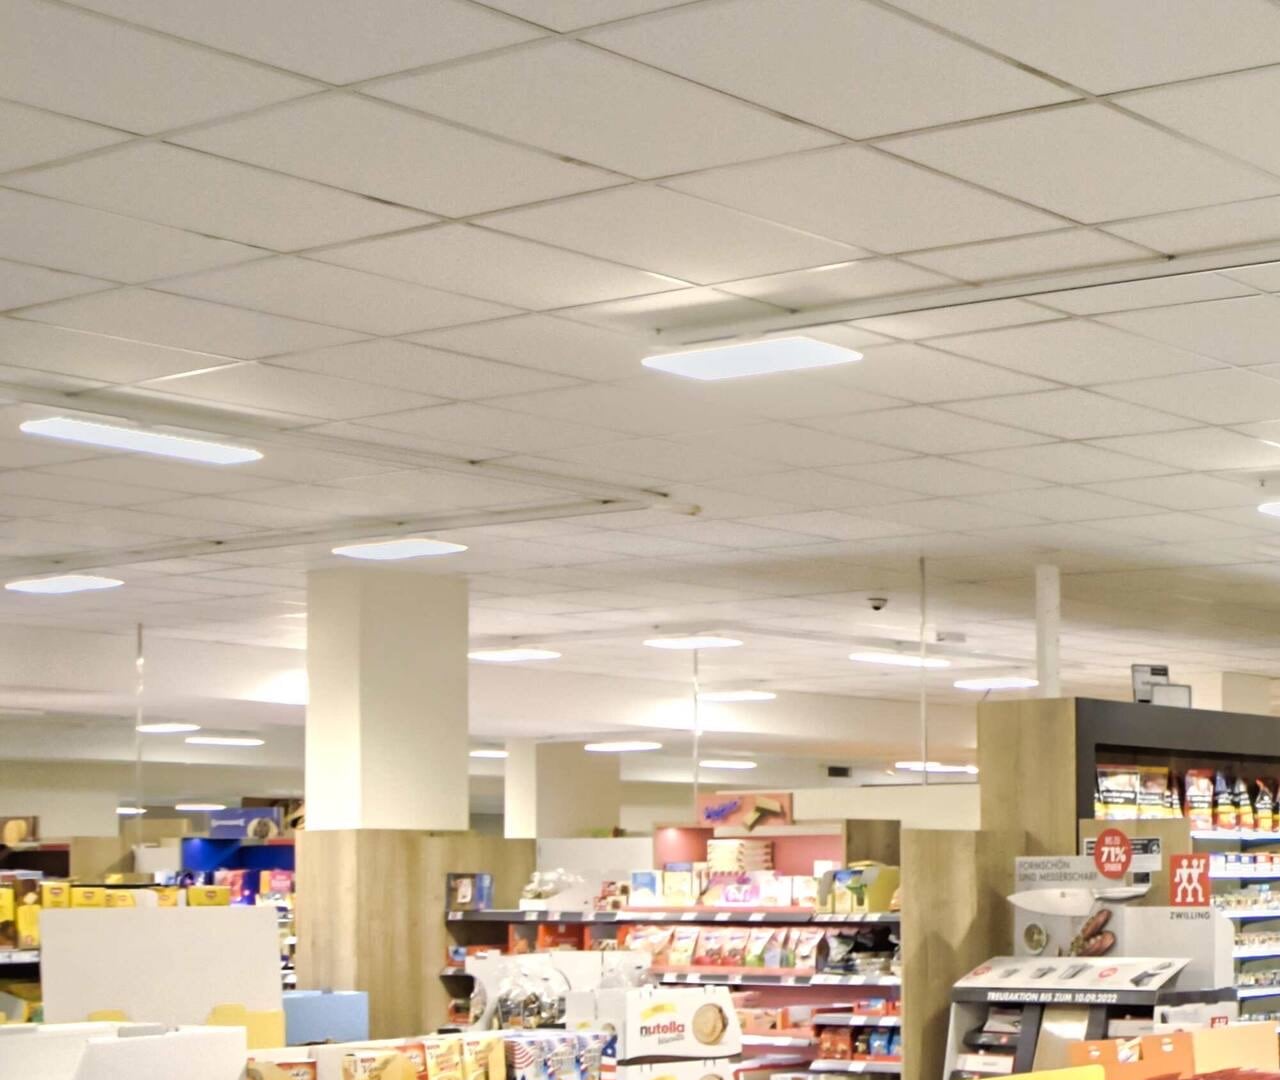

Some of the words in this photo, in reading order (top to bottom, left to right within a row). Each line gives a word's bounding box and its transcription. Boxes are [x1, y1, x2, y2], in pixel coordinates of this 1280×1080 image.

[1101, 846, 1126, 863] 71%
[1170, 911, 1210, 920] ZWILLING
[640, 1021, 685, 1037] nutella
